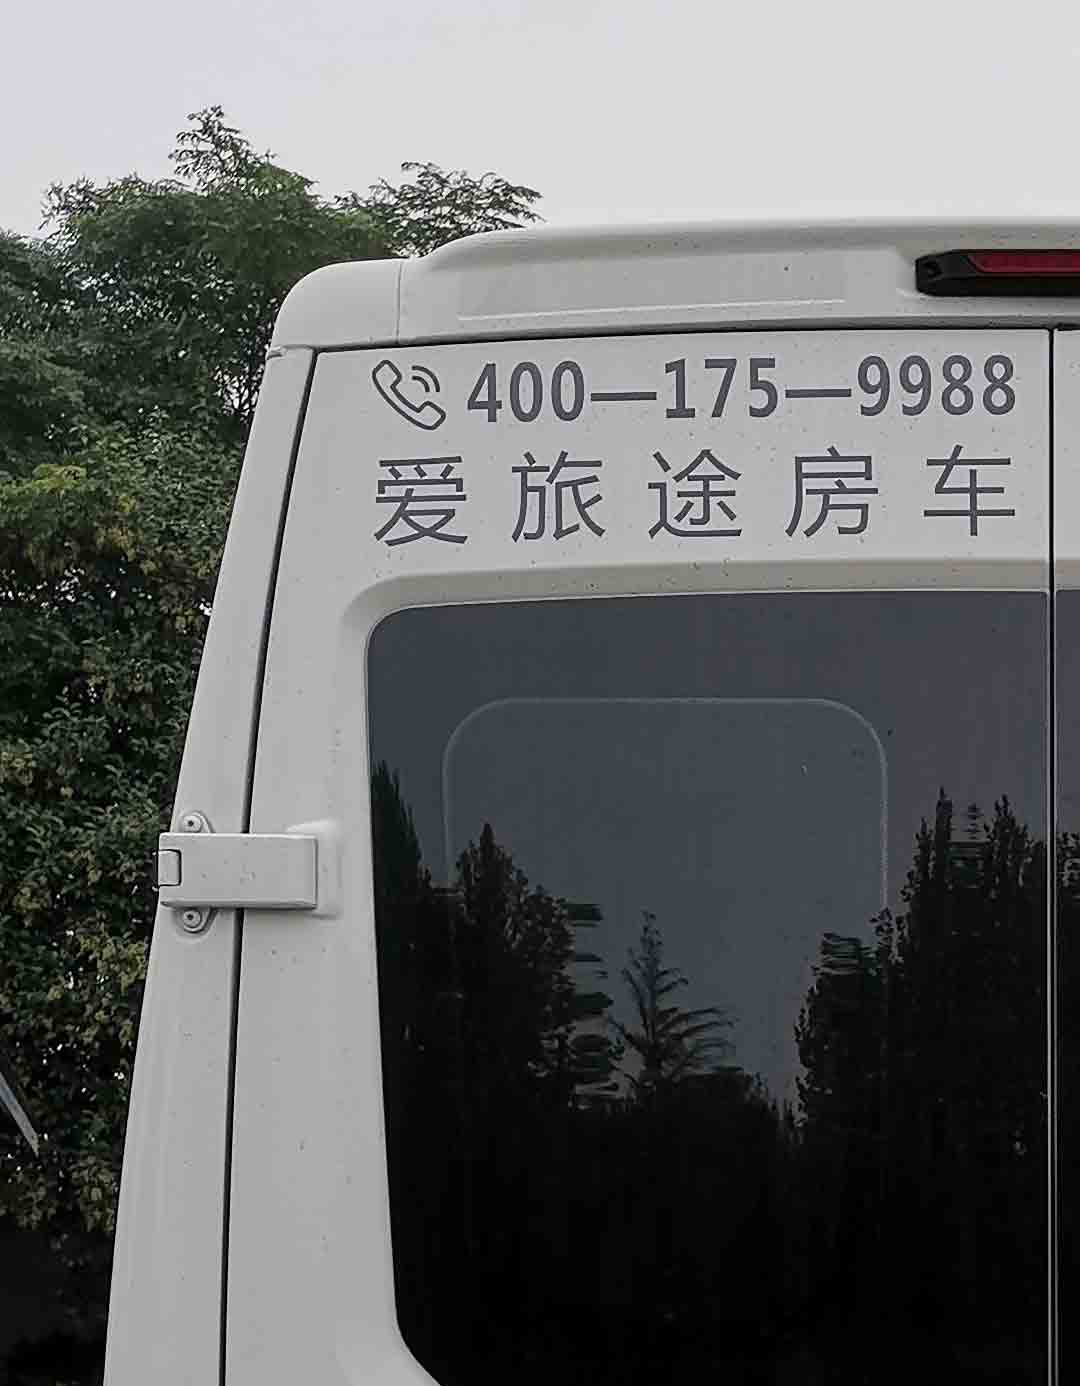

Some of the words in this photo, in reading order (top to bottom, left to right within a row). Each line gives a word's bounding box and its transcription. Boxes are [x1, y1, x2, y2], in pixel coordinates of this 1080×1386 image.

[374, 445, 1015, 546] 爱旅途房车
